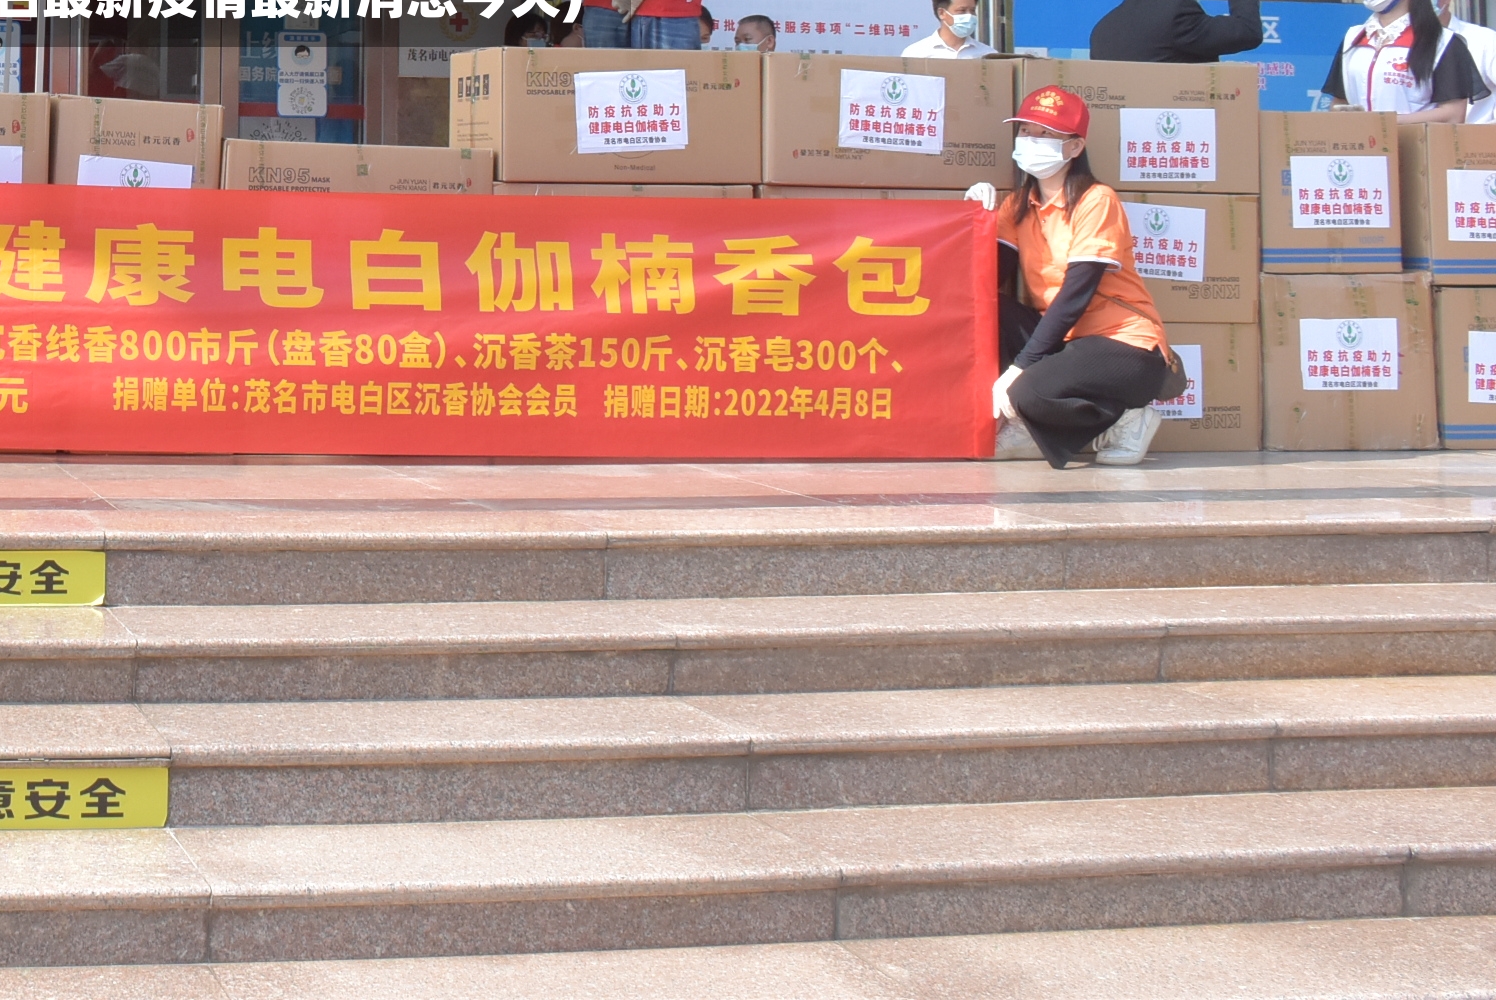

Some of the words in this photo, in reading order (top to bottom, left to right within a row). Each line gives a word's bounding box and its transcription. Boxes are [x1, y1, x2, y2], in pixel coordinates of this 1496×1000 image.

[407, 48, 462, 62] 茂名市电
[526, 72, 575, 87] KN9
[588, 103, 680, 118] 防疫抗疫助力
[849, 103, 938, 121] 防疫抗疫助力
[588, 119, 681, 134] 健康电白伽楠香包
[849, 118, 937, 137] 健康电白伽楠香包
[1127, 141, 1210, 153] 防疫抗疫助力
[1127, 156, 1210, 169] 健康电白伽楠香包
[248, 167, 310, 183] KN95
[1299, 188, 1382, 200] 防疫抗疫助力
[1299, 203, 1383, 215] 健康电白伽楠香包
[1307, 350, 1391, 362] 防疫抗疫助力
[1307, 365, 1392, 378] 健康电白伽楠香包
[112, 375, 578, 418] 捐赠单位:茂名市电白区沉香协会会员
[604, 384, 893, 420] 捐赠日期:2022年4月8日
